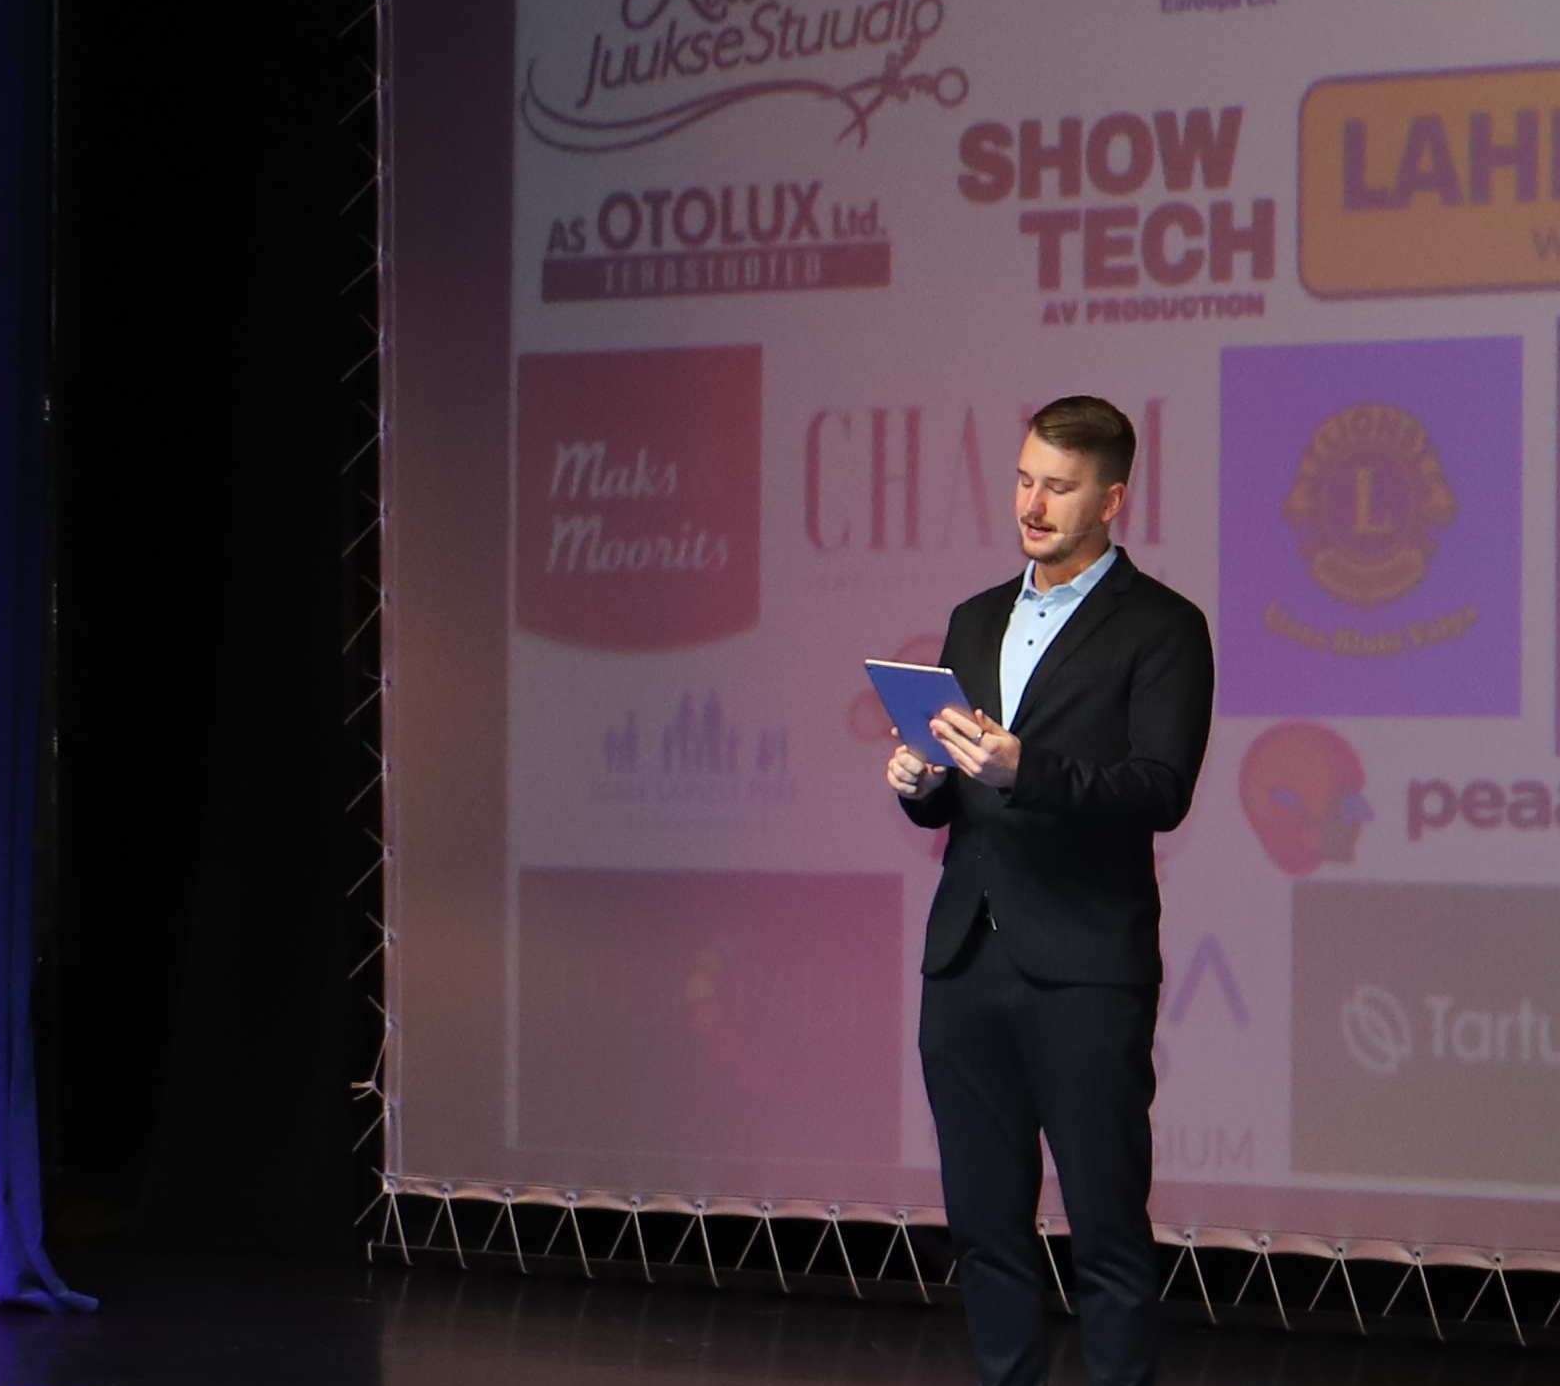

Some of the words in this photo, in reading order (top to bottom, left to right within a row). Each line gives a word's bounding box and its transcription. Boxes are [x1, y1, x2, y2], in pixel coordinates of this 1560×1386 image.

[956, 104, 1245, 205] SHOW
[596, 180, 824, 252] OTOLUX
[1018, 197, 1276, 294] TECH
[1040, 299, 1079, 326] AV
[1085, 292, 1266, 326] PRODUCTION
[548, 439, 680, 503] Maks
[544, 513, 731, 574] Moorits
